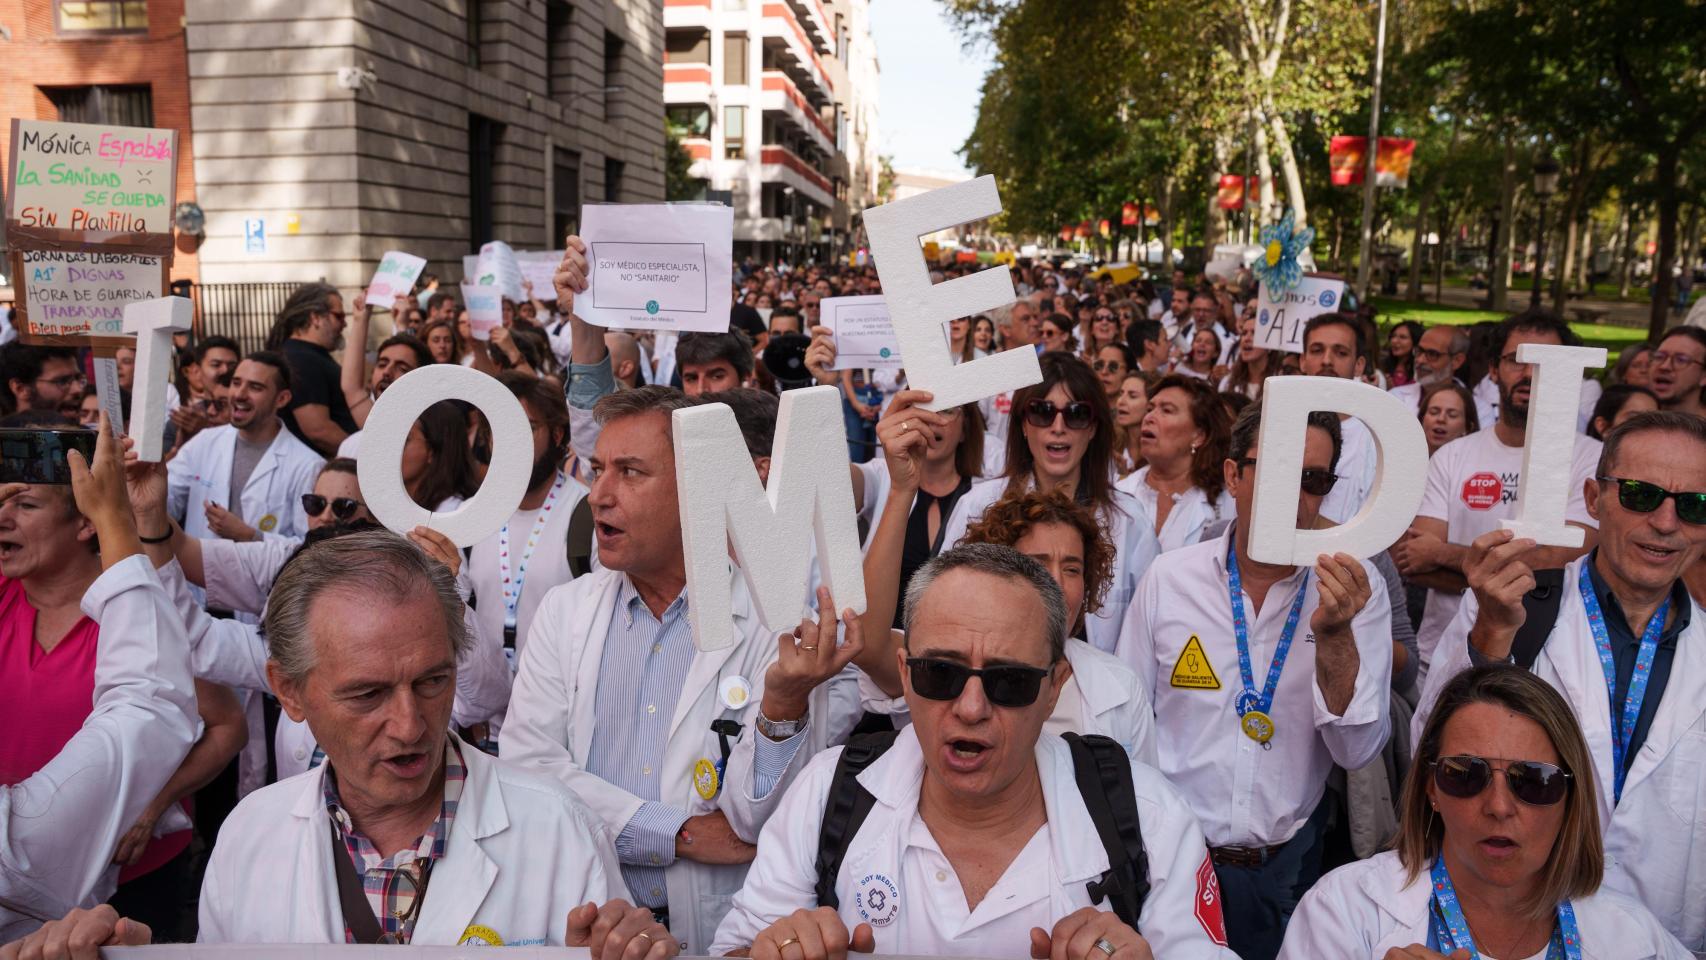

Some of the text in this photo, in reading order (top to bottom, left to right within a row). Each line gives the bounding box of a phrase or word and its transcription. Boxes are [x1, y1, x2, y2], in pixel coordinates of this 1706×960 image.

[17, 160, 41, 186] La
[83, 191, 165, 207] SE QUEDA
[23, 251, 157, 265] JORNADAS LABORALES
[600, 261, 700, 272] SOY MÉDICO ESPECIALISTA,
[68, 267, 125, 283] DIGNAS
[28, 285, 154, 303] HORA DE GUARDIA
[863, 174, 1043, 411] E
[42, 305, 121, 319] TRABAJADA
[30, 321, 58, 335] Bien
[121, 296, 194, 462] T
[357, 364, 535, 547] O
[1502, 344, 1608, 548] I
[1249, 376, 1428, 566] D
[1470, 479, 1496, 487] STOP
[672, 384, 867, 652] M
[861, 874, 897, 898] SOY MEDICO
[1203, 871, 1217, 906] STO
[861, 909, 869, 919] DE
